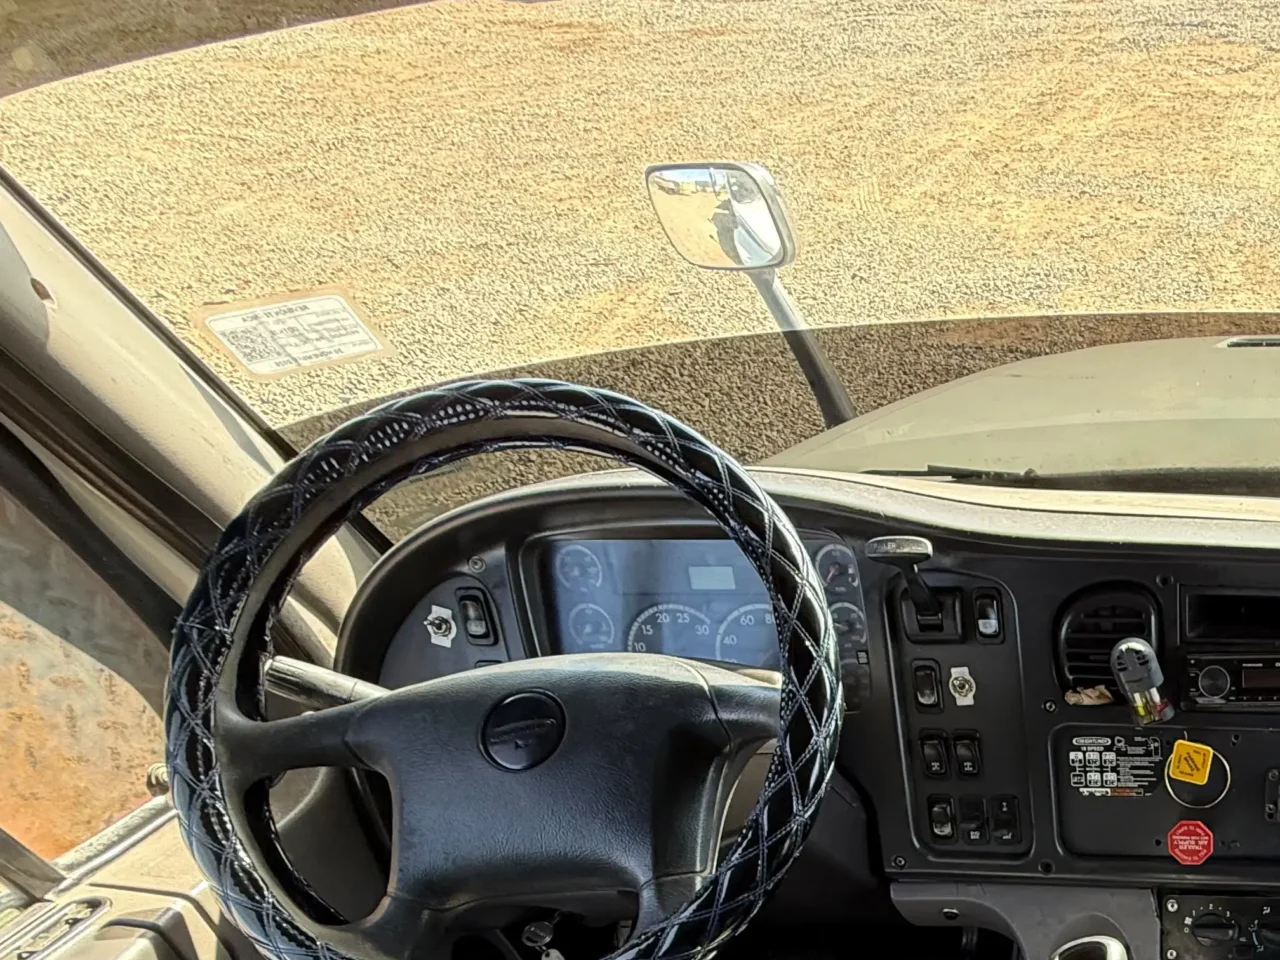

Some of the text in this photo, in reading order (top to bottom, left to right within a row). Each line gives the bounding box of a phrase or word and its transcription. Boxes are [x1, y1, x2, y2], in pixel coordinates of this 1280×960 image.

[655, 612, 670, 623] 20
[675, 612, 690, 623] 25
[740, 615, 754, 626] 60
[642, 624, 653, 635] 15
[695, 625, 710, 636] 30
[723, 635, 737, 645] 40
[634, 642, 646, 652] 10
